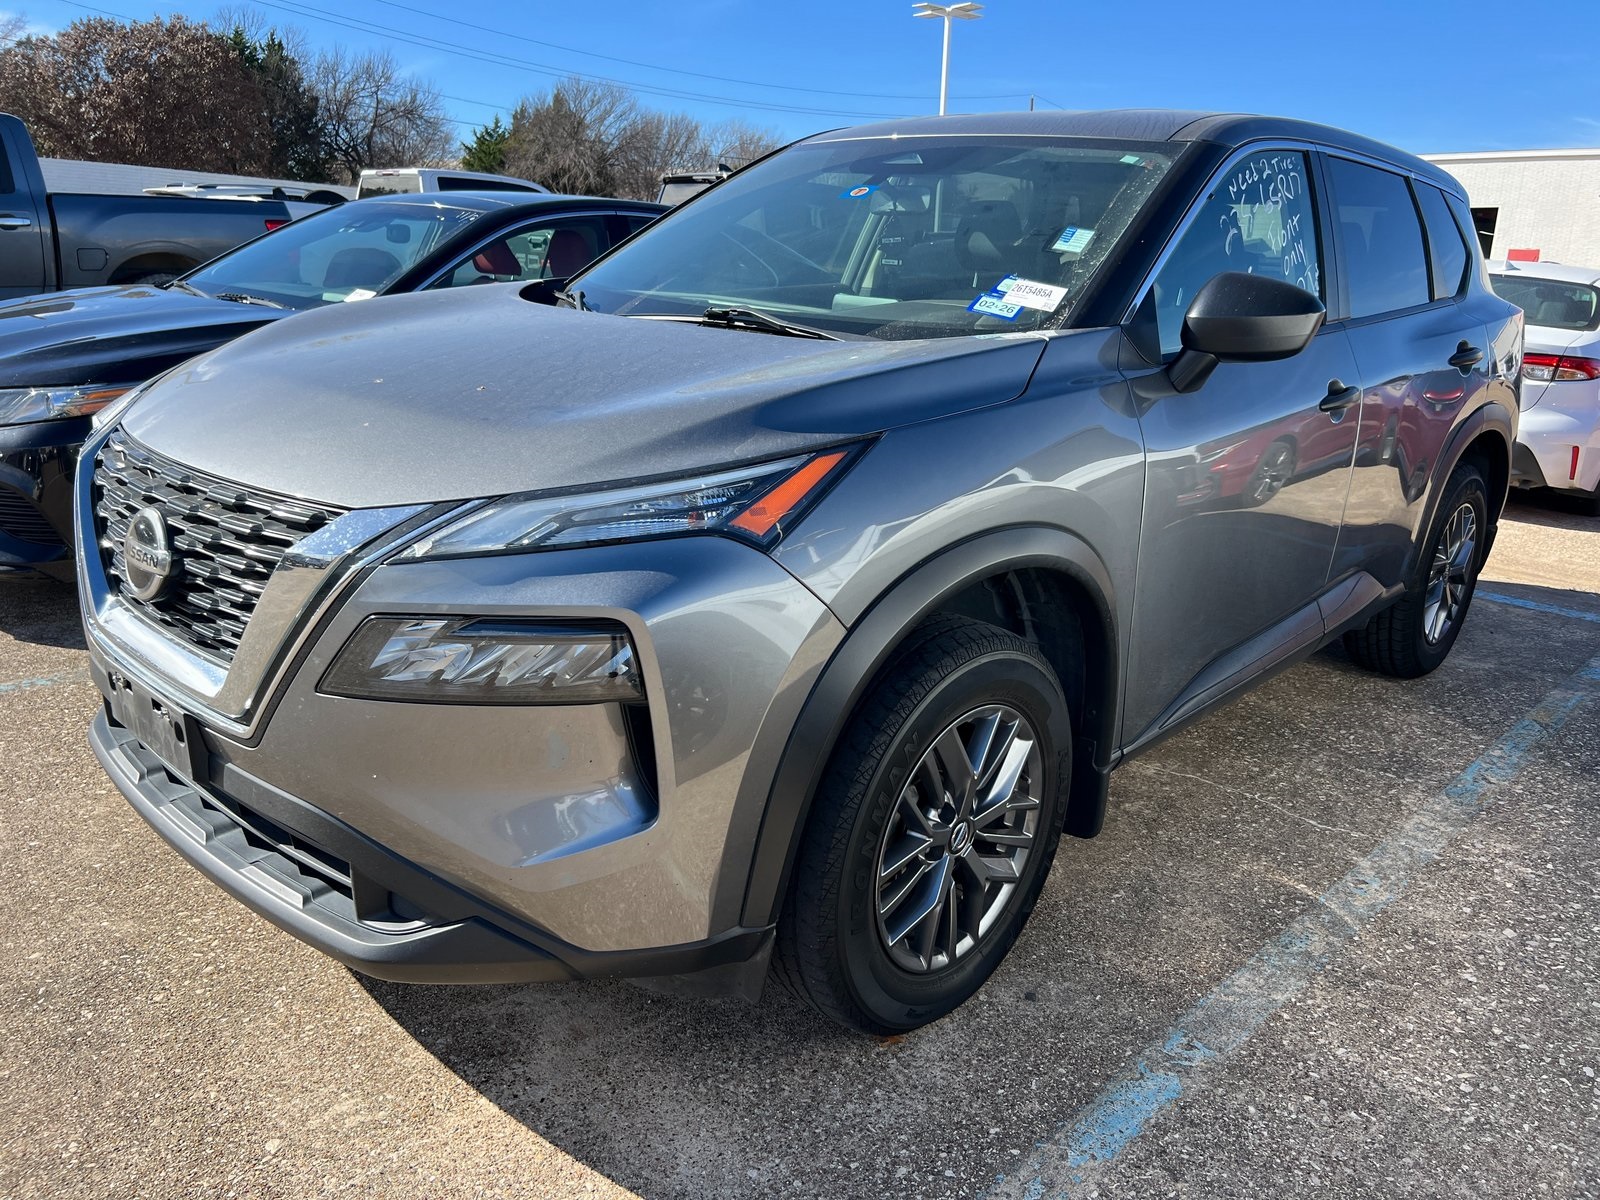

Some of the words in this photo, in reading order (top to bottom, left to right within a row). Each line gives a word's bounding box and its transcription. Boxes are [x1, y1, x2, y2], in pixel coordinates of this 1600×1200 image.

[1260, 158, 1272, 180] 2
[125, 543, 160, 569] NISSAN
[850, 731, 920, 937] IRONMAN
